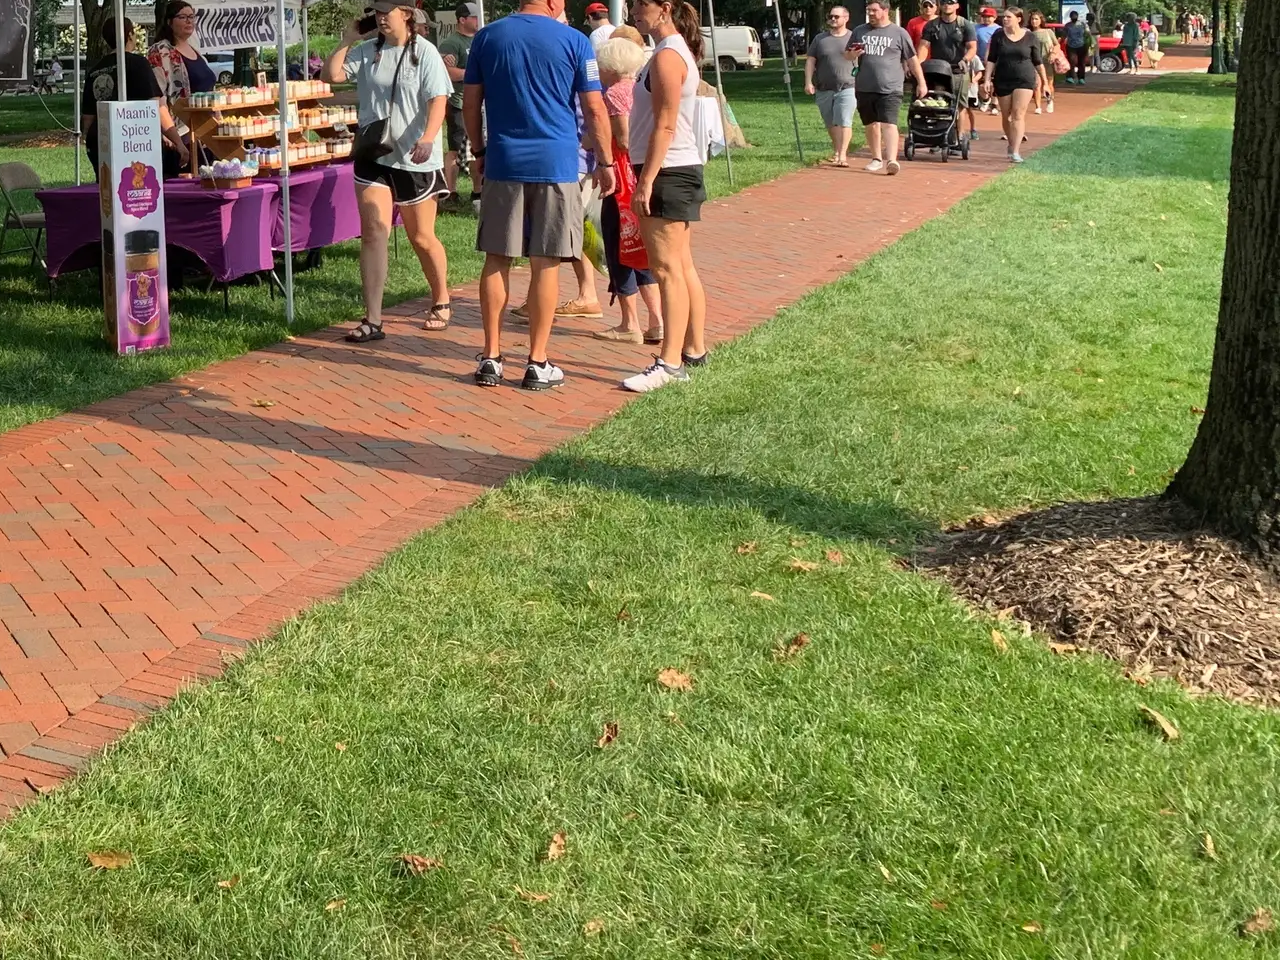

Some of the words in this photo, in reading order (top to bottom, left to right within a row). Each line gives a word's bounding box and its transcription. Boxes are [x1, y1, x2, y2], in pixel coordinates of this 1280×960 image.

[861, 35, 894, 48] SASHAY
[865, 44, 888, 57] AWAY
[116, 106, 157, 120] Maani's
[121, 123, 150, 139] Spice
[123, 140, 153, 154] Blend
